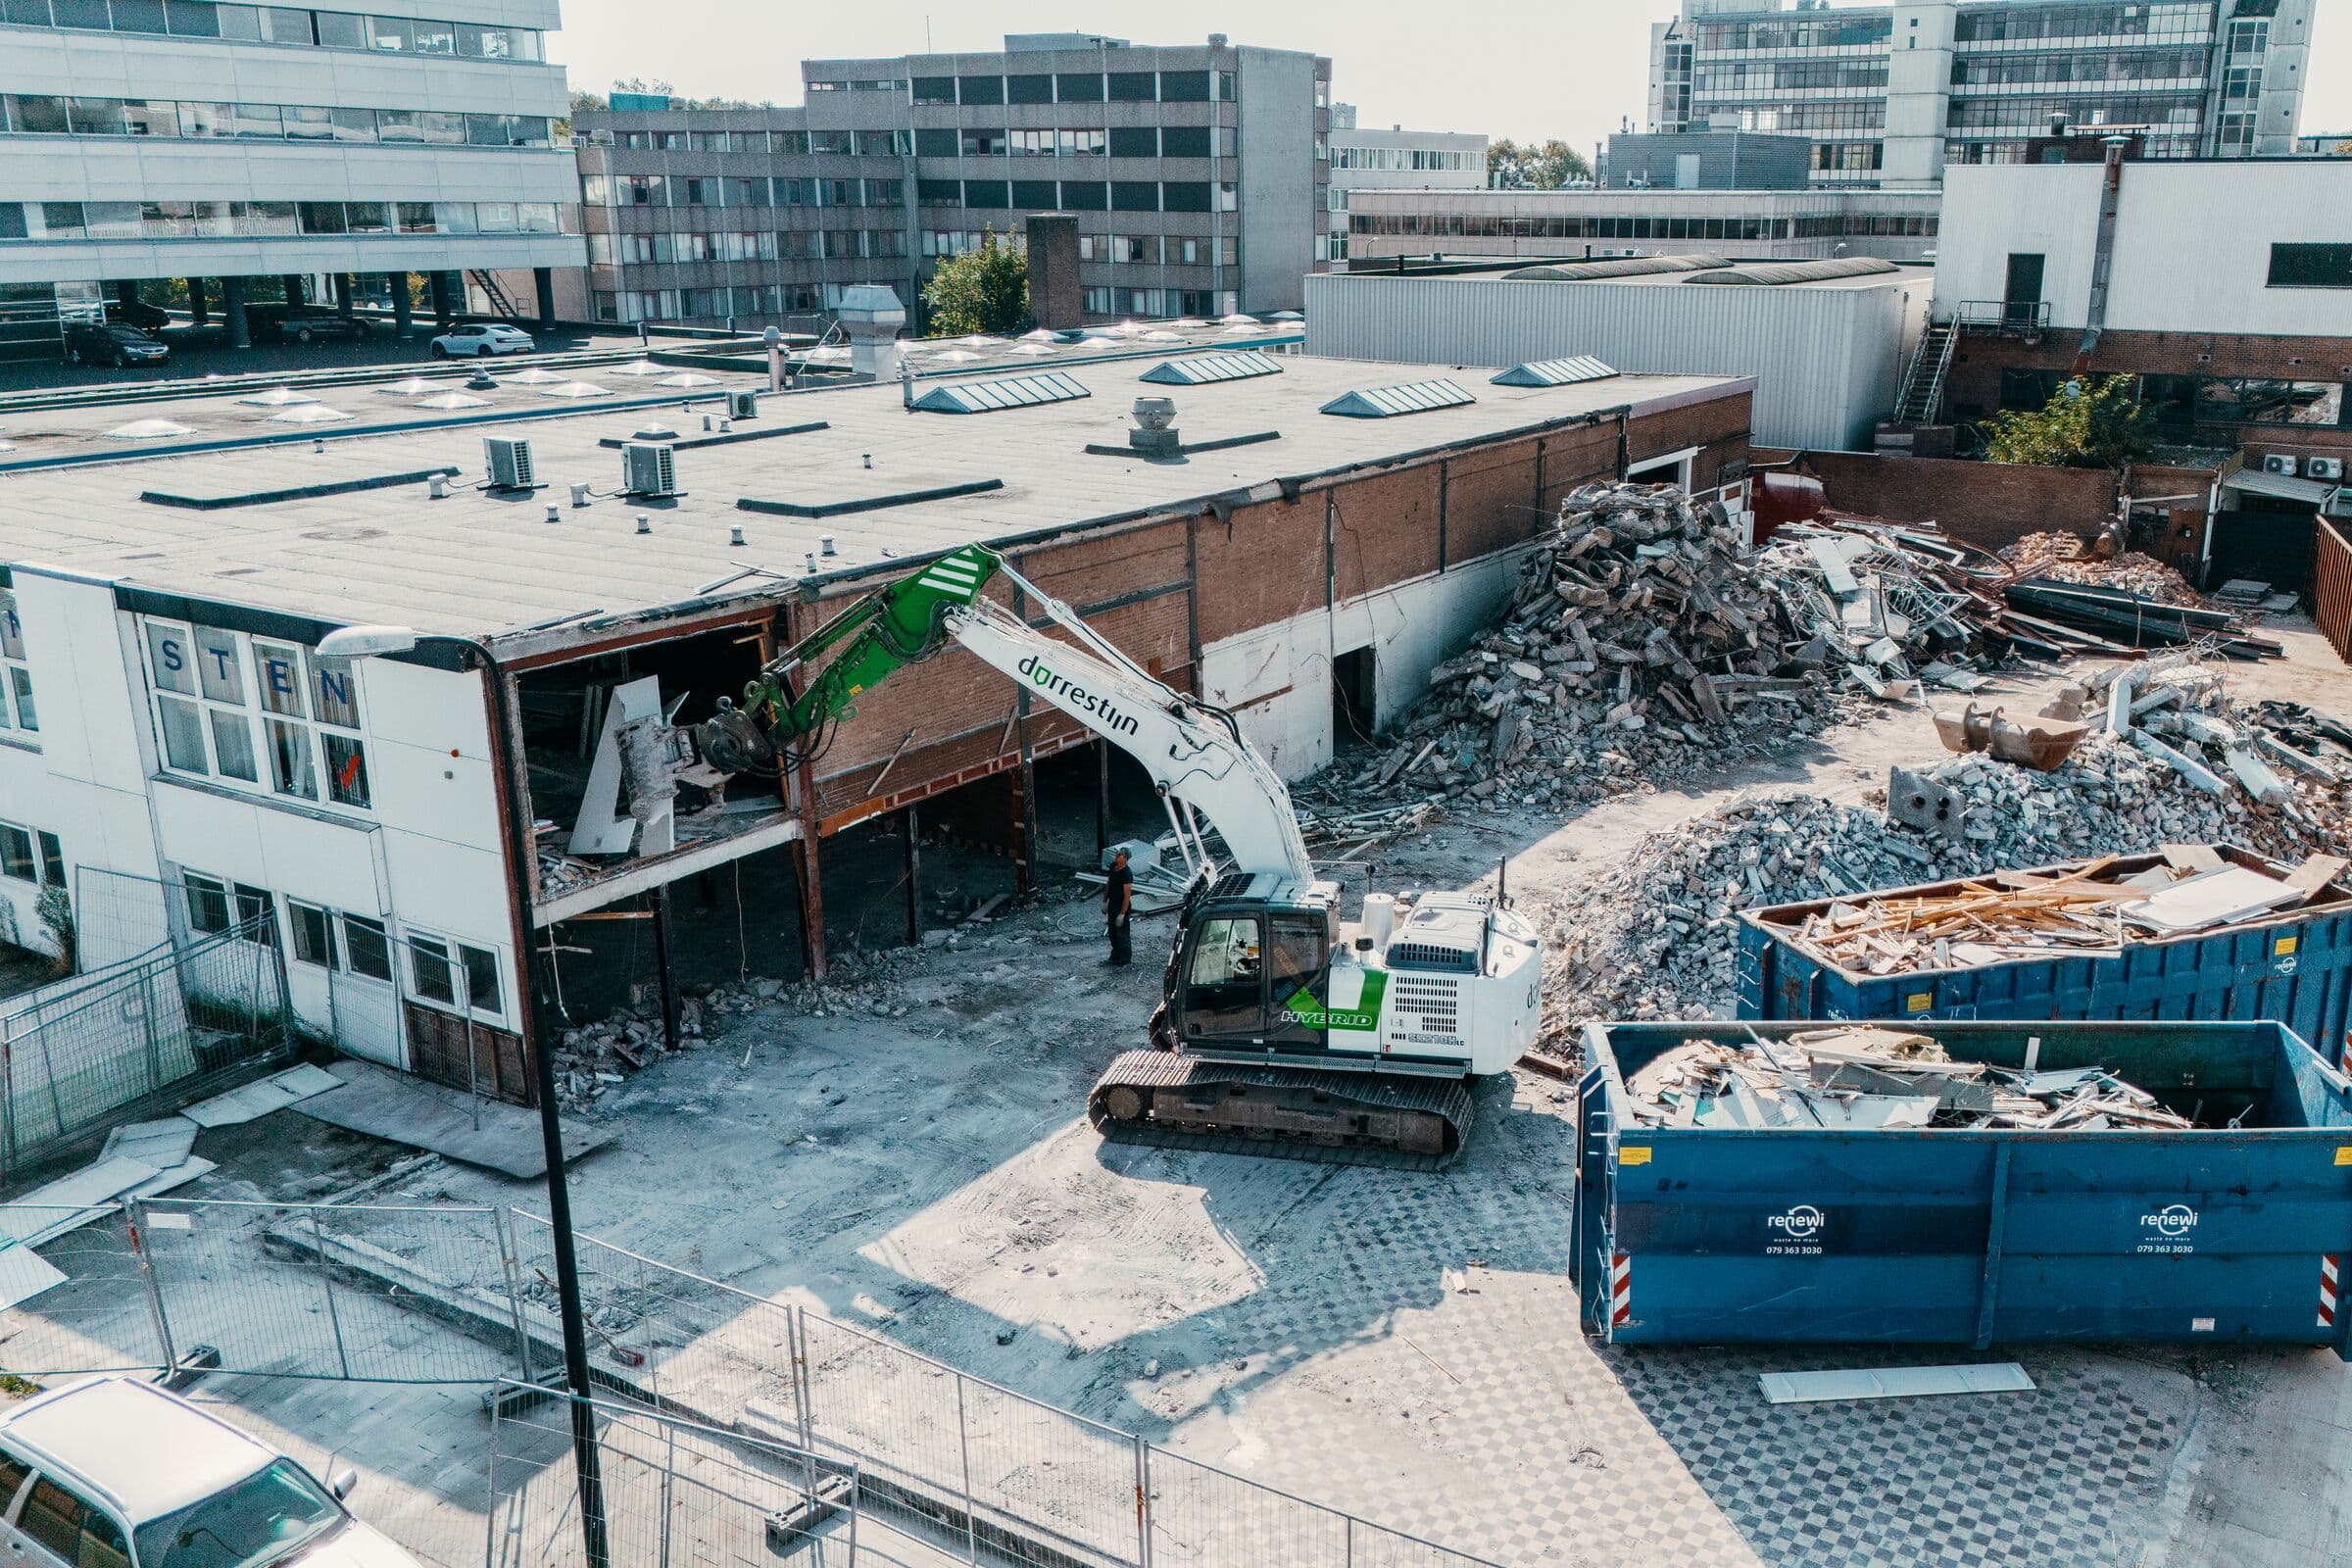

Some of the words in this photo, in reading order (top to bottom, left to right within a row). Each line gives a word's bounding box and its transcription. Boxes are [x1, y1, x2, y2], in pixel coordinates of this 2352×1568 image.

[1280, 1010, 1374, 1027] HYBRID
[1767, 1209, 1825, 1230] renewi
[2139, 1208, 2199, 1229] renewi
[1766, 1246, 1783, 1254] 079
[1785, 1246, 1800, 1254] 363
[1801, 1246, 1823, 1254] 3030
[2136, 1245, 2153, 1253] 079
[2154, 1245, 2171, 1253] 363
[2172, 1245, 2193, 1253] 3030
